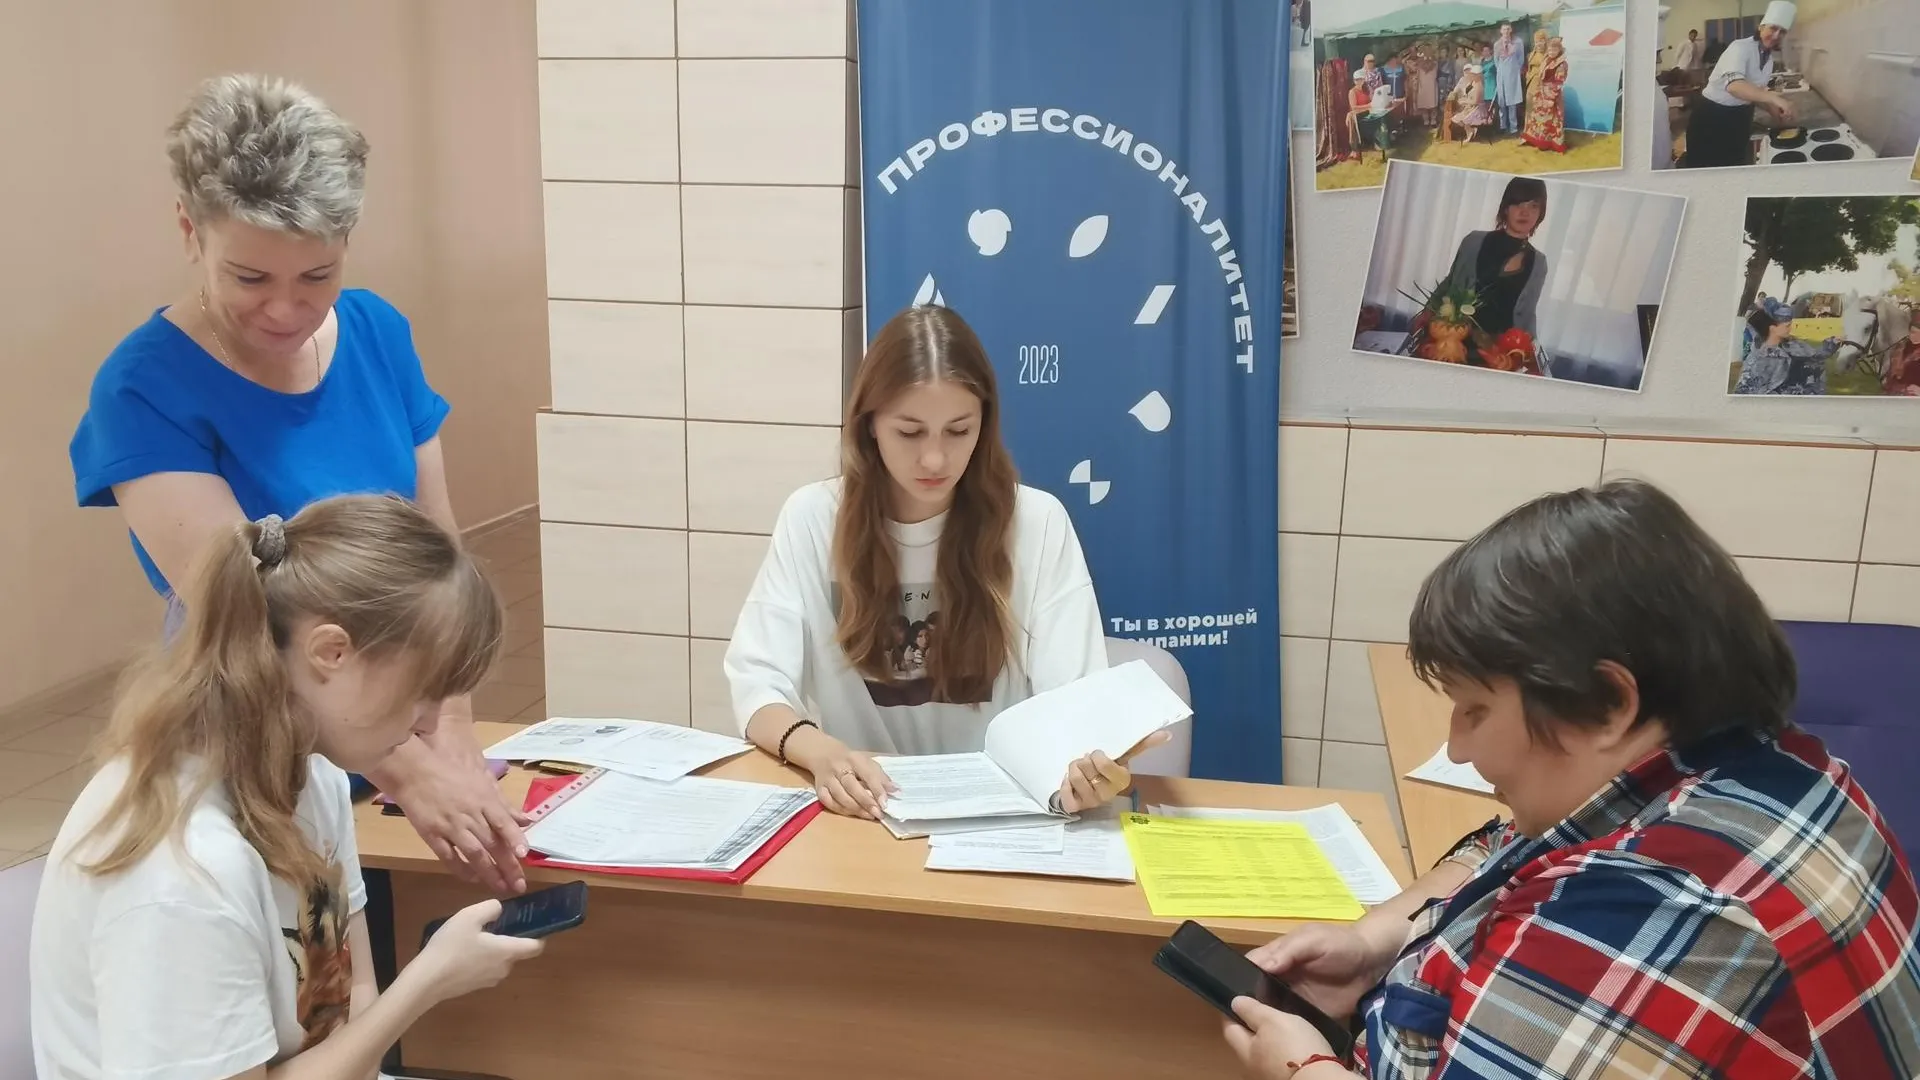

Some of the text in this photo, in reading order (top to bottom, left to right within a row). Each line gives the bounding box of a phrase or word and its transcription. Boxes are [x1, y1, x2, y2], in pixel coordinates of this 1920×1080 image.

[876, 106, 1254, 374] ПРОФЕССИОНАЛИТЕТ
[1018, 344, 1059, 385] 2023
[1111, 608, 1257, 633] Ты в хорошей
